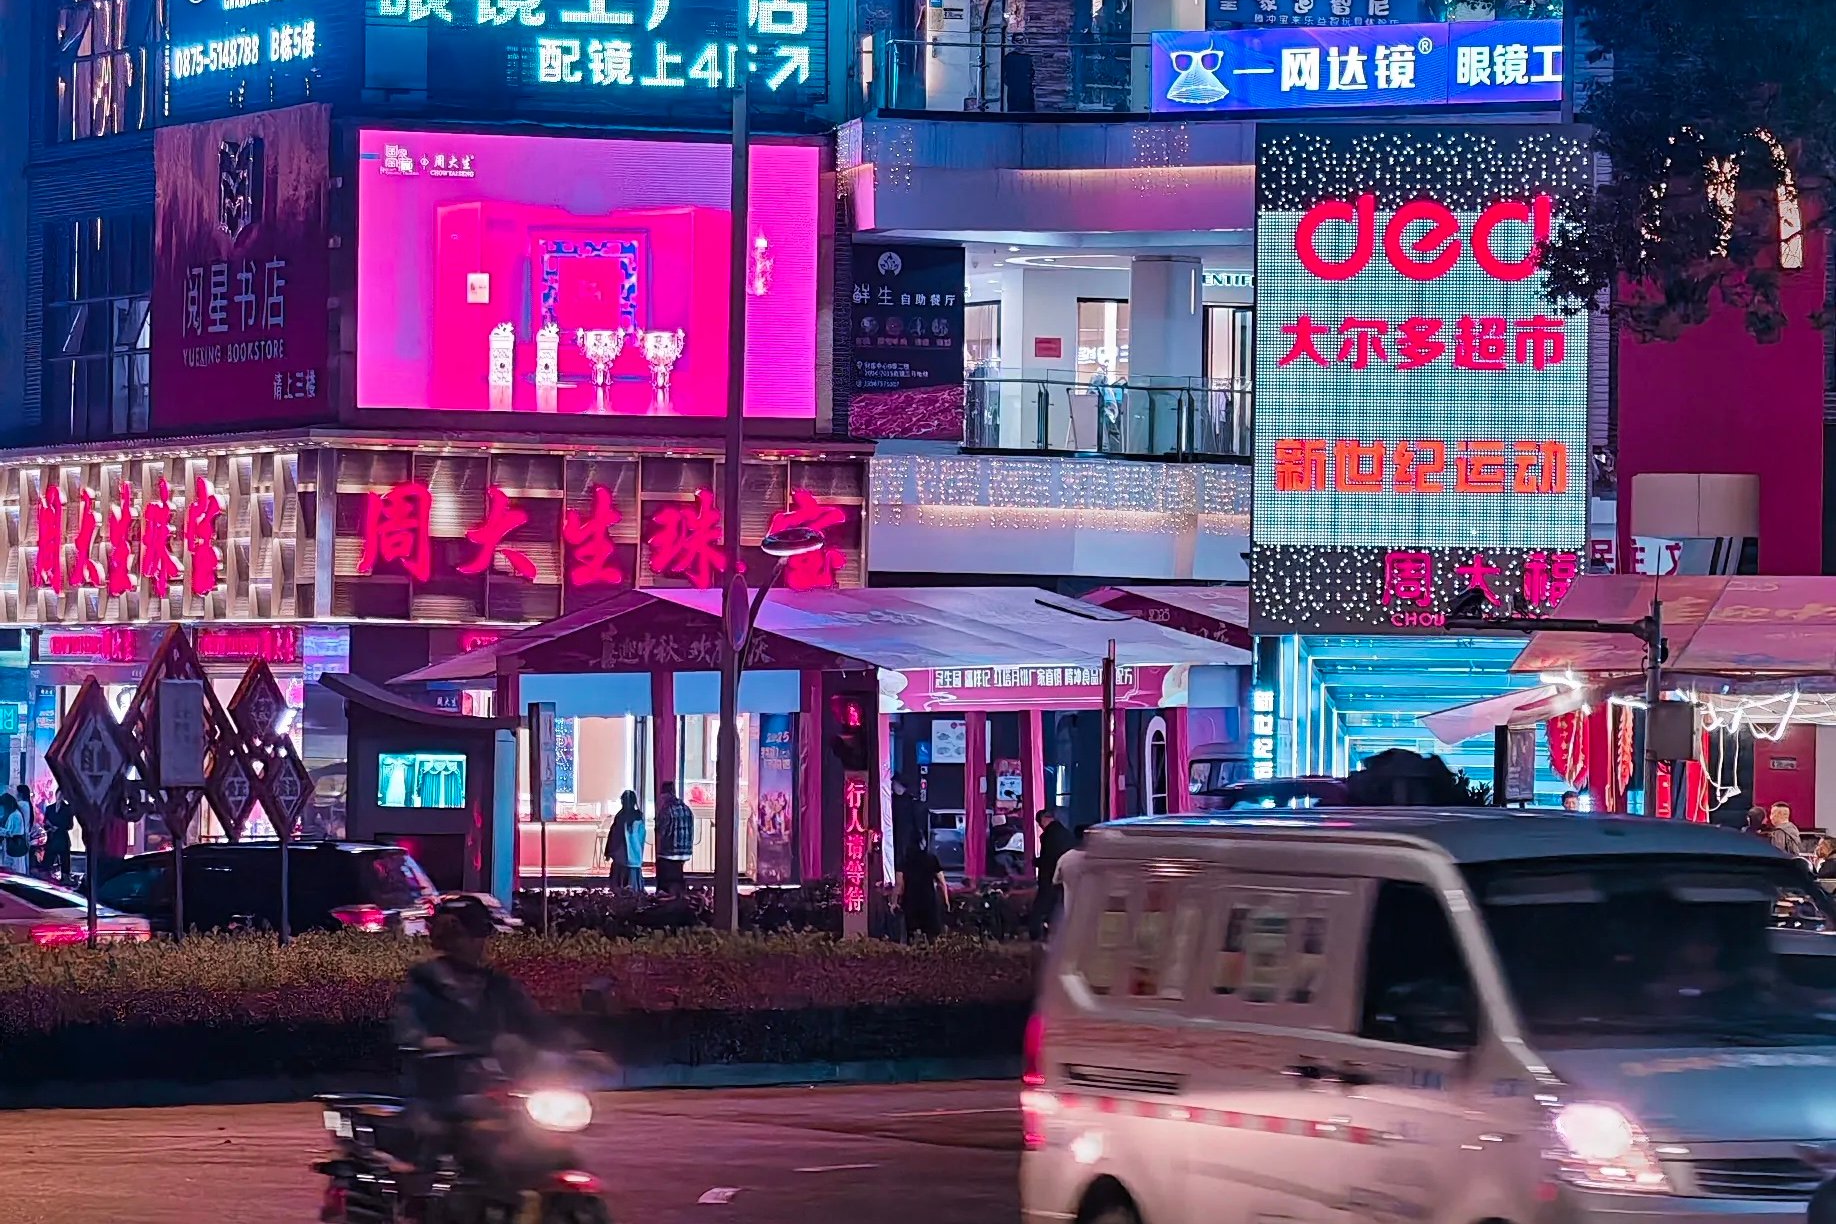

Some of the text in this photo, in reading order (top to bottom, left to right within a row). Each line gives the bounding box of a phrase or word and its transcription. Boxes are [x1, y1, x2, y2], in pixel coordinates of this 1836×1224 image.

[1233, 45, 1563, 91] 一网达镜 眼镜工
[182, 255, 285, 338] 阅星书店
[227, 339, 284, 364] BOOKSTORE
[1277, 314, 1566, 371] 大尔多超市
[1274, 439, 1569, 494] 新世纪运动
[356, 481, 847, 590] 周大生珠宝
[1382, 551, 1578, 608] 周大福
[846, 781, 865, 913] 行人请等待
